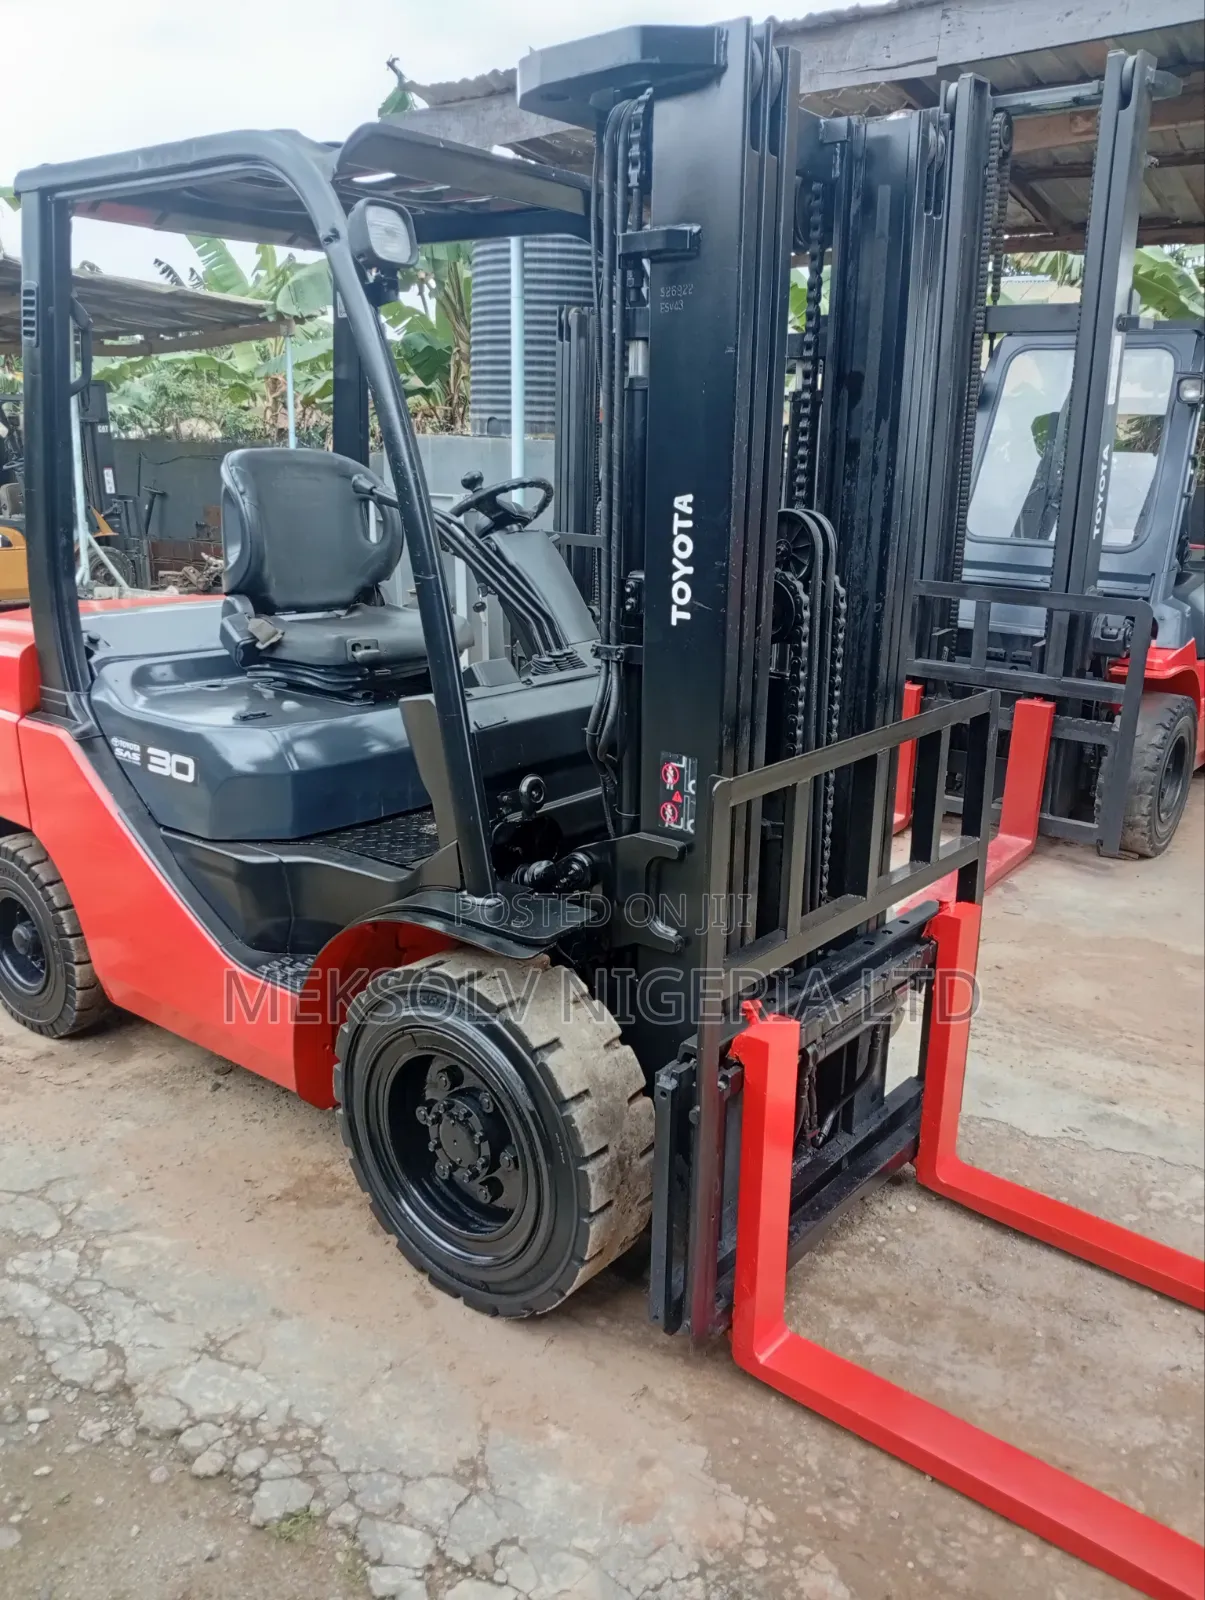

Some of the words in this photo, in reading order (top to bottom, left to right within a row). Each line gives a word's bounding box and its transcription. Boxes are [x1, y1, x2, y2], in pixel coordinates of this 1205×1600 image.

[98, 425, 108, 433] CAT
[1092, 444, 1110, 540] TOYOTA
[671, 493, 694, 626] TOYOTA
[114, 747, 141, 761] SAS
[147, 747, 195, 783] 30
